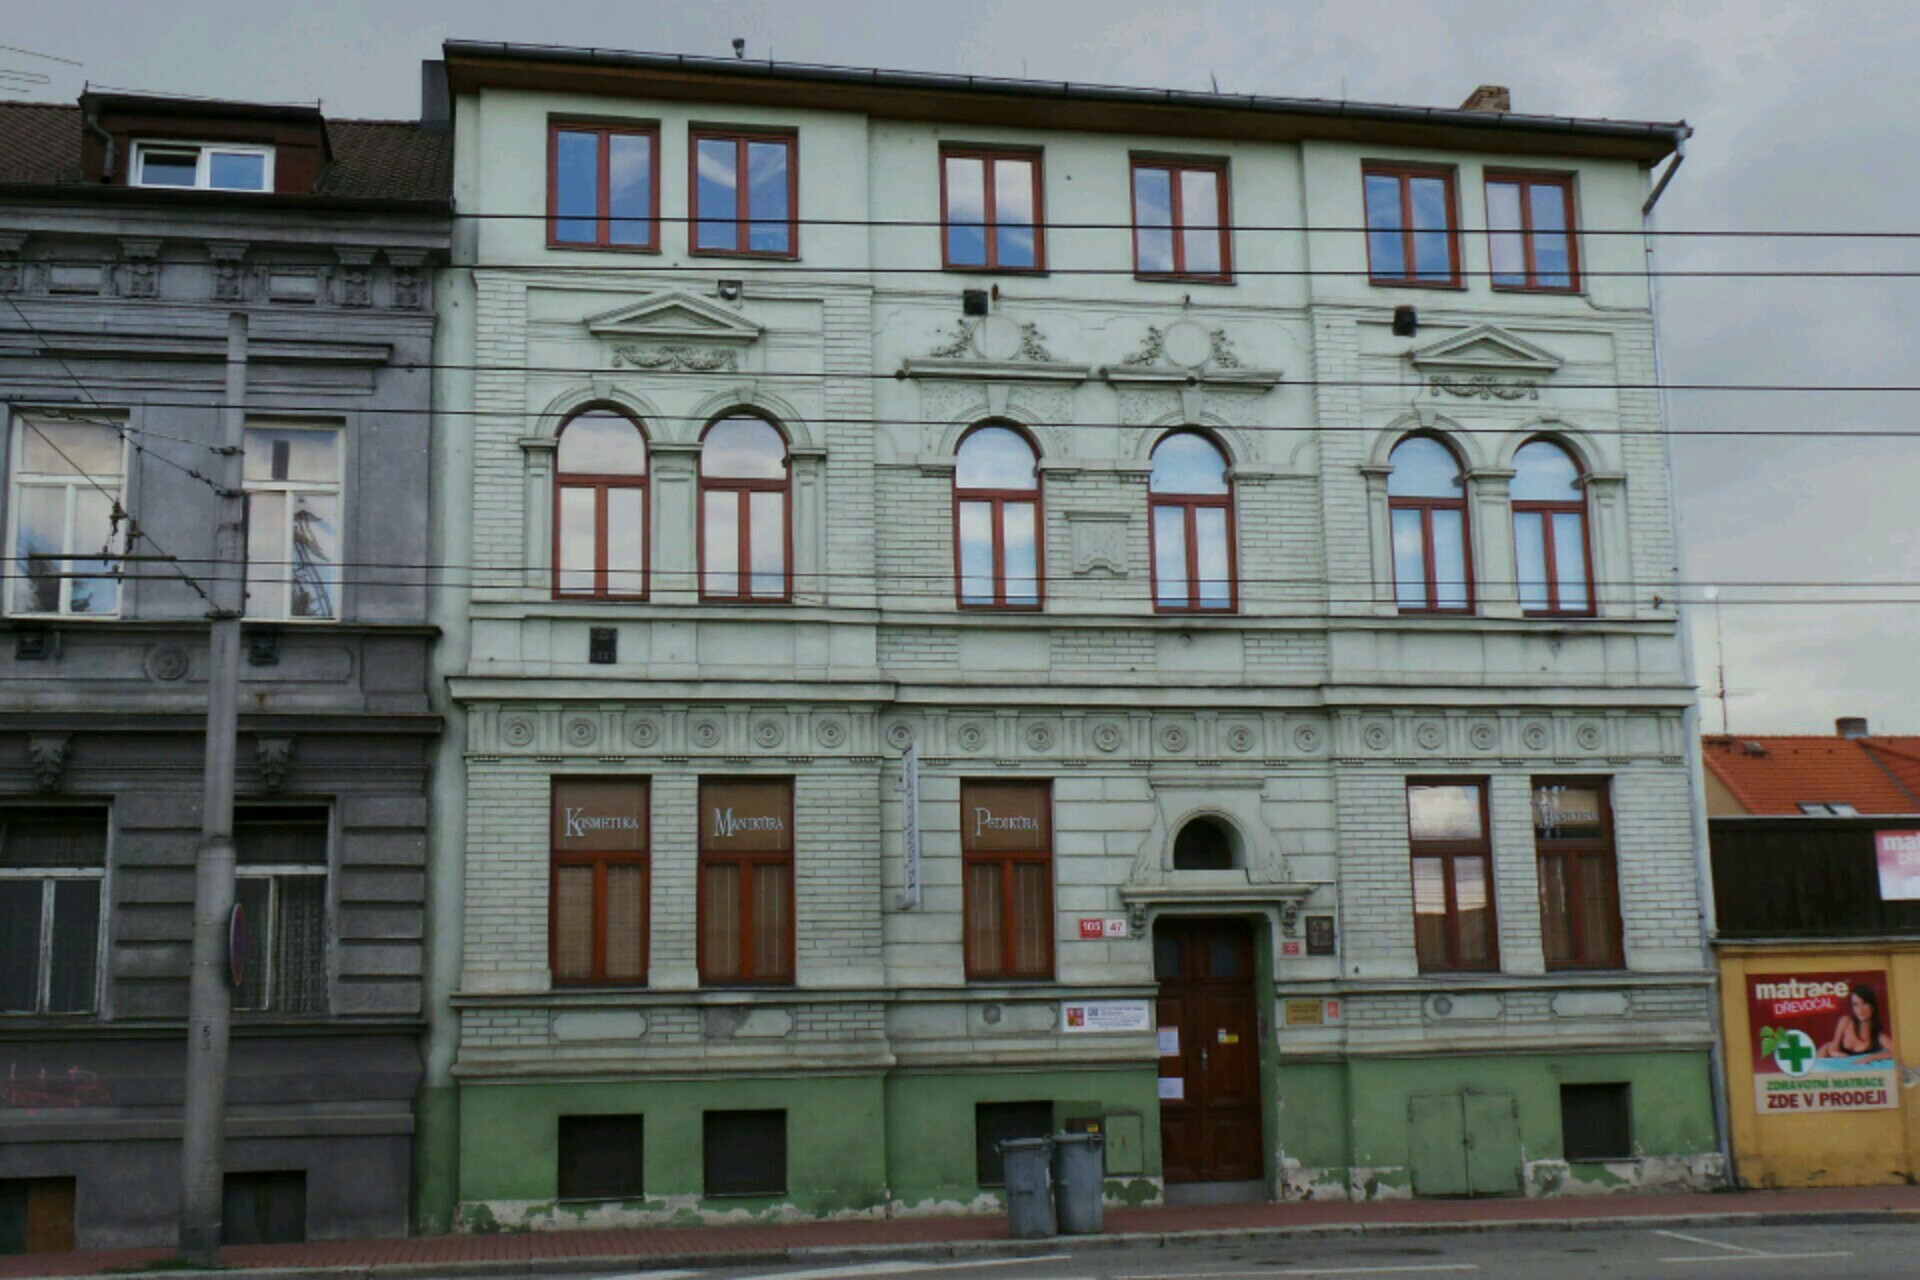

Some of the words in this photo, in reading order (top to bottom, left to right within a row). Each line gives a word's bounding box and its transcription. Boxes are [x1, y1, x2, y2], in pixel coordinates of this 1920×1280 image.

[1755, 978, 1849, 999] matrace
[1832, 1077, 1885, 1089] MATRACE
[1767, 1093, 1800, 1109] ZDE
[1803, 1092, 1814, 1107] V
[1819, 1090, 1887, 1106] PRODEJI
